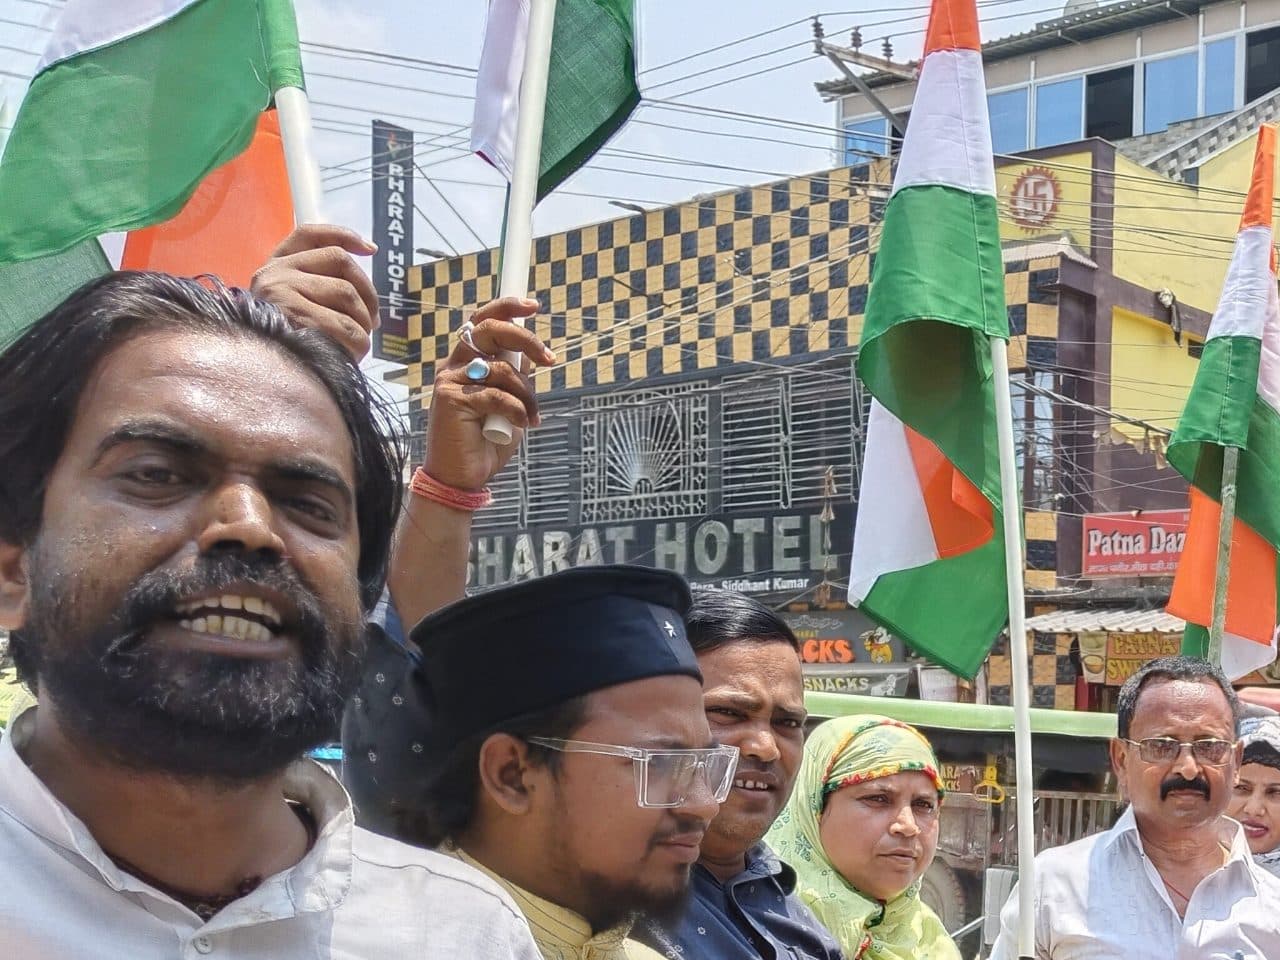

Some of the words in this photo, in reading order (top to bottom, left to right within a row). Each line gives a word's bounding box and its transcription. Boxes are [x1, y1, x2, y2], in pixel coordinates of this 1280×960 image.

[388, 163, 405, 246] BHARAT
[387, 250, 404, 320] HOTEL
[654, 514, 838, 576] HOTEL
[1088, 529, 1146, 556] Patna
[1149, 526, 1187, 555] Daz
[722, 577, 769, 592] Siddhant
[772, 576, 810, 591] Kumar
[802, 639, 853, 663] CKS
[1114, 635, 1175, 655] PATNA
[803, 676, 870, 692] SNACKS
